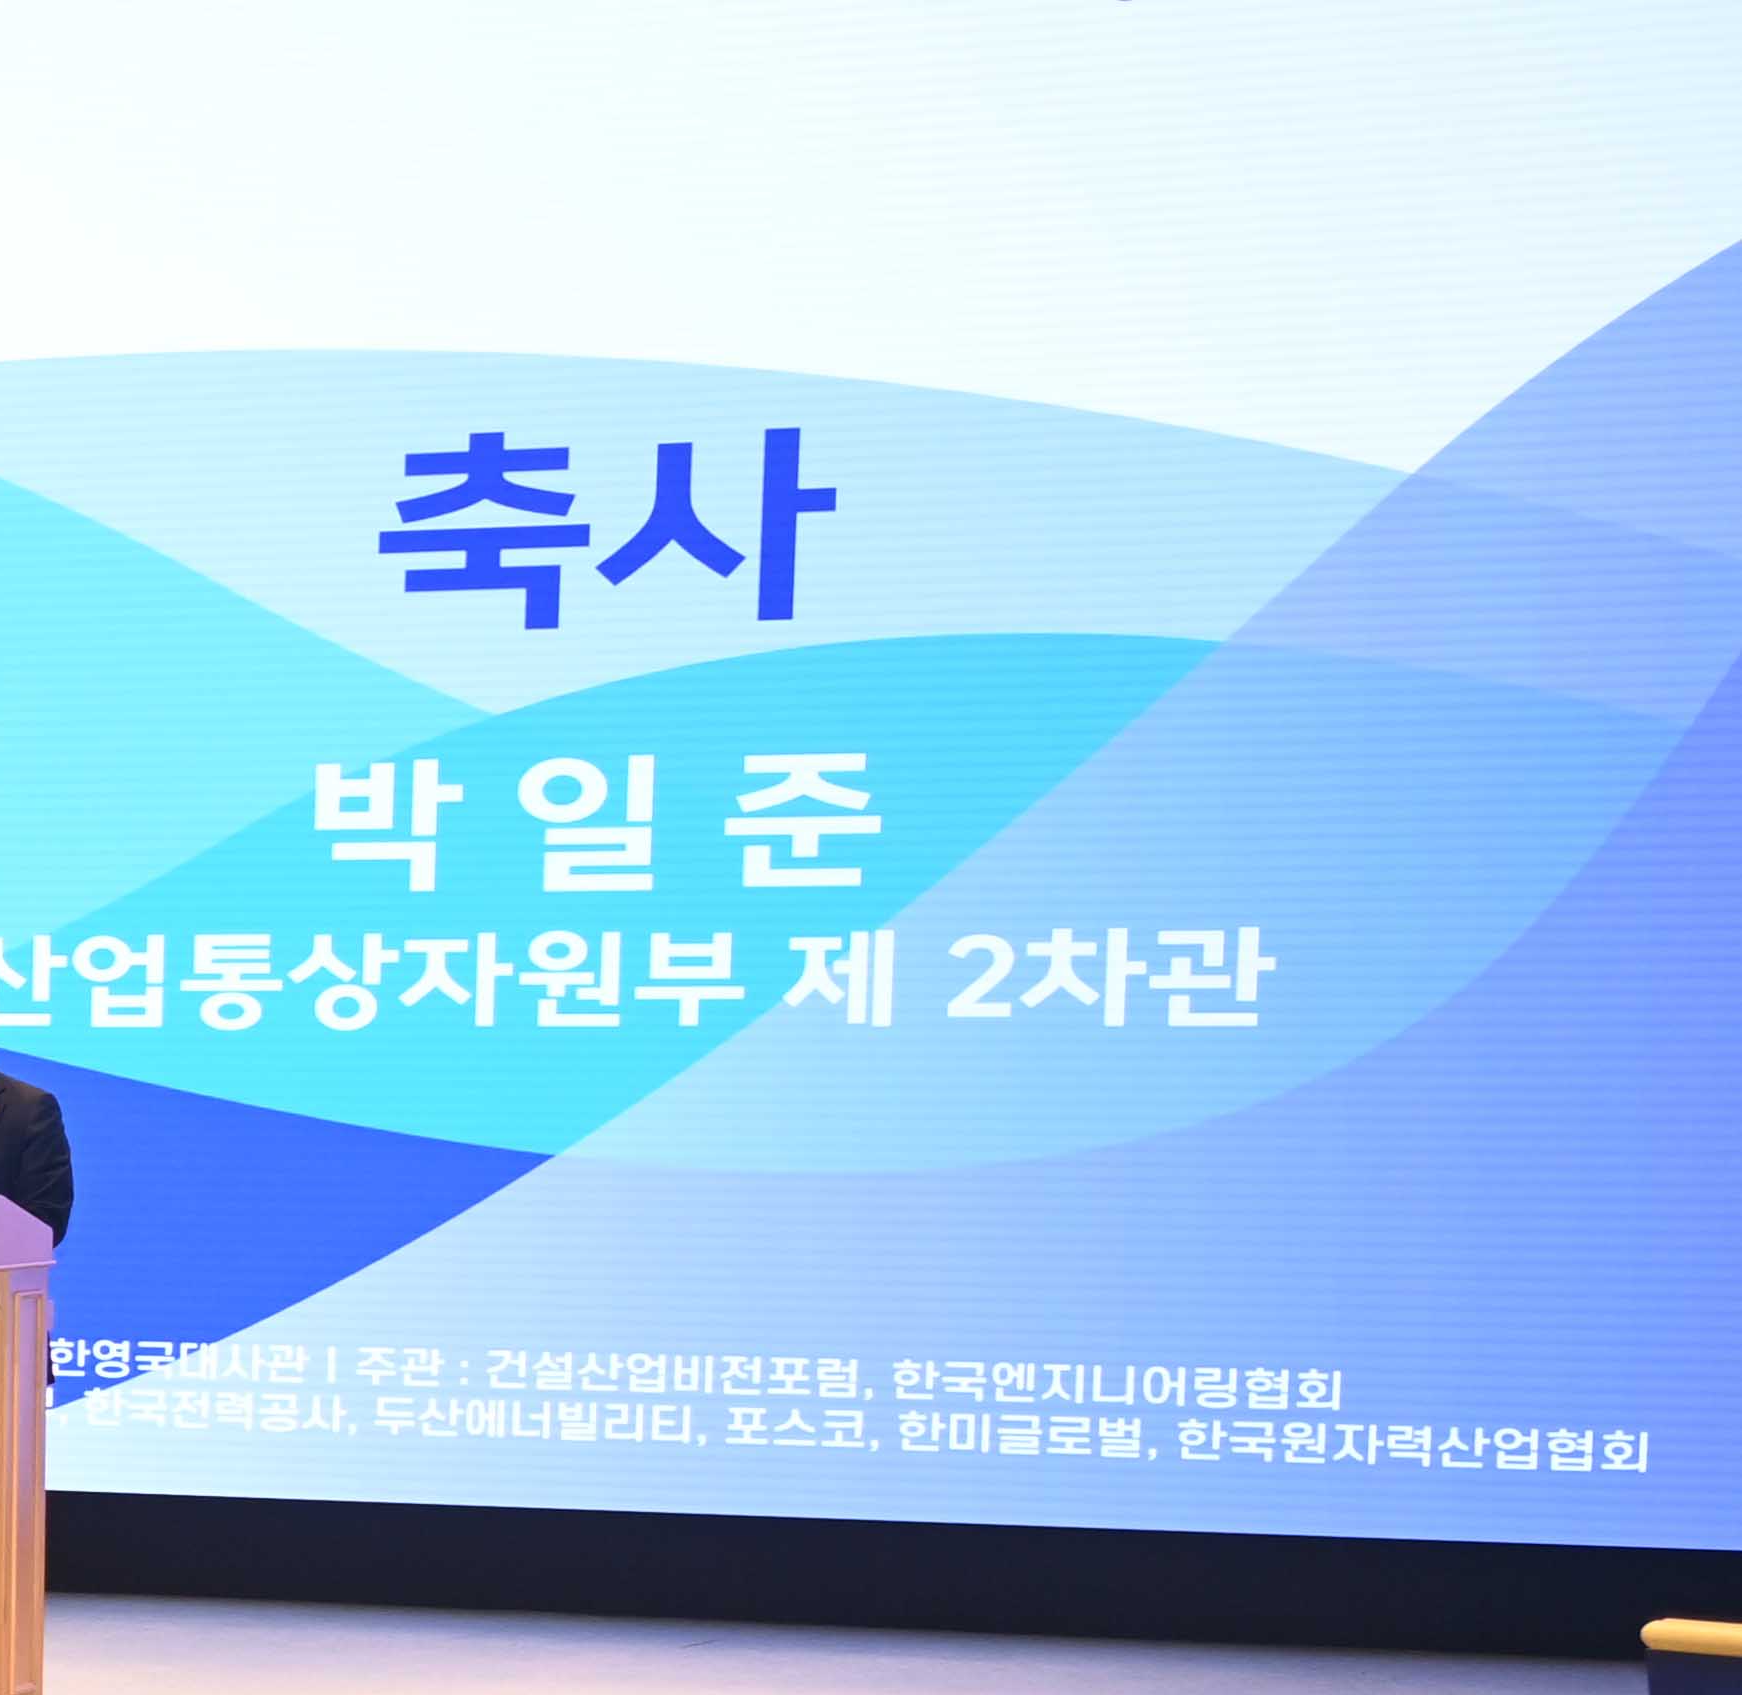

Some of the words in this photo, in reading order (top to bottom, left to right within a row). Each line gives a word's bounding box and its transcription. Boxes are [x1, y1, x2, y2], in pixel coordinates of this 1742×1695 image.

[378, 426, 837, 630] 축사
[783, 928, 895, 1029] 제
[946, 926, 1276, 1029] 2차관
[355, 1346, 444, 1387] 주관
[486, 1349, 874, 1401] 건설산업비전포럼,
[892, 1358, 1342, 1412] 한국엔지니어링협회
[83, 1387, 357, 1436] 한국전력공사,
[374, 1397, 706, 1447] 두산에너빌리티,
[725, 1405, 879, 1452] 포스코,
[898, 1411, 1158, 1462] 한미글로벌,
[1177, 1417, 1649, 1474] 한국원자력산업협회
